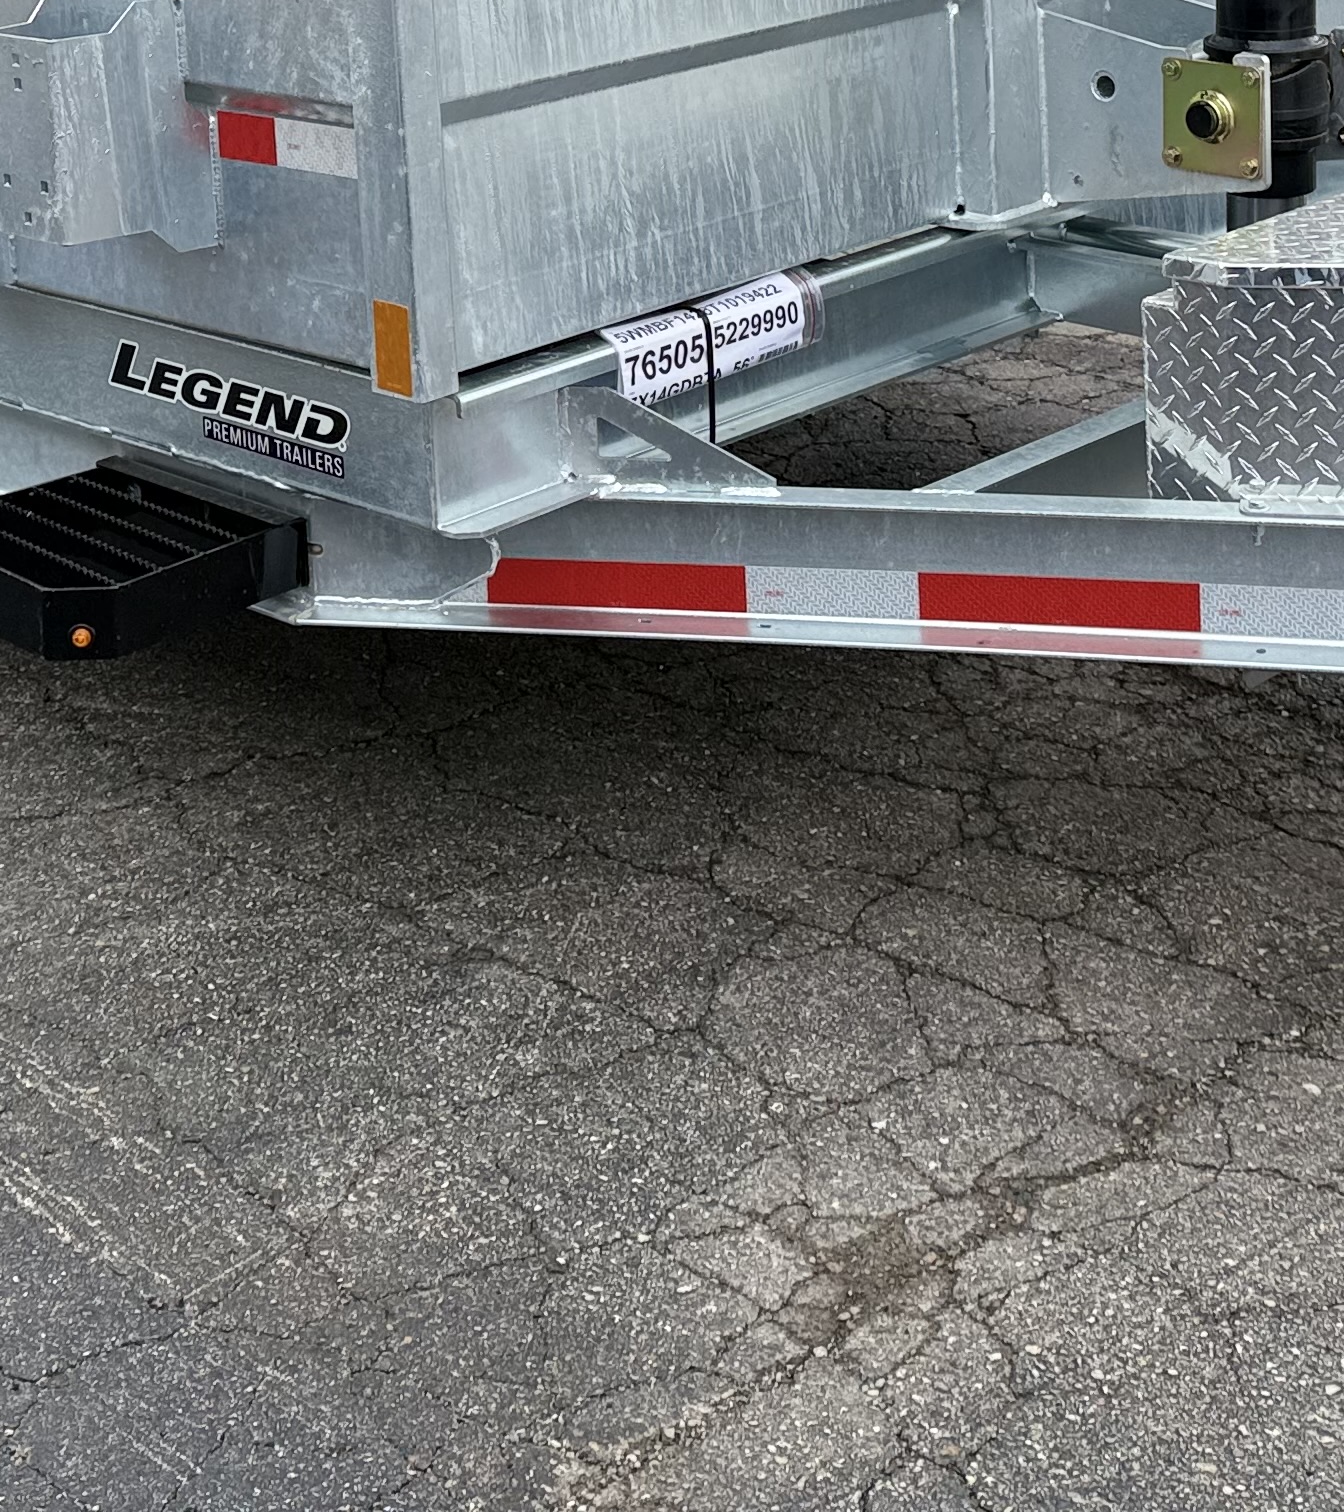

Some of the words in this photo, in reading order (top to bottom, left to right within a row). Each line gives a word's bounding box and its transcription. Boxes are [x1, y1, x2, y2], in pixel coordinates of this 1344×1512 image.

[624, 333, 705, 387] 76505
[714, 301, 799, 349] 5229990
[109, 340, 351, 449] LEGEND
[204, 418, 270, 455] PREMIUM
[273, 439, 344, 478] TRAILERS
